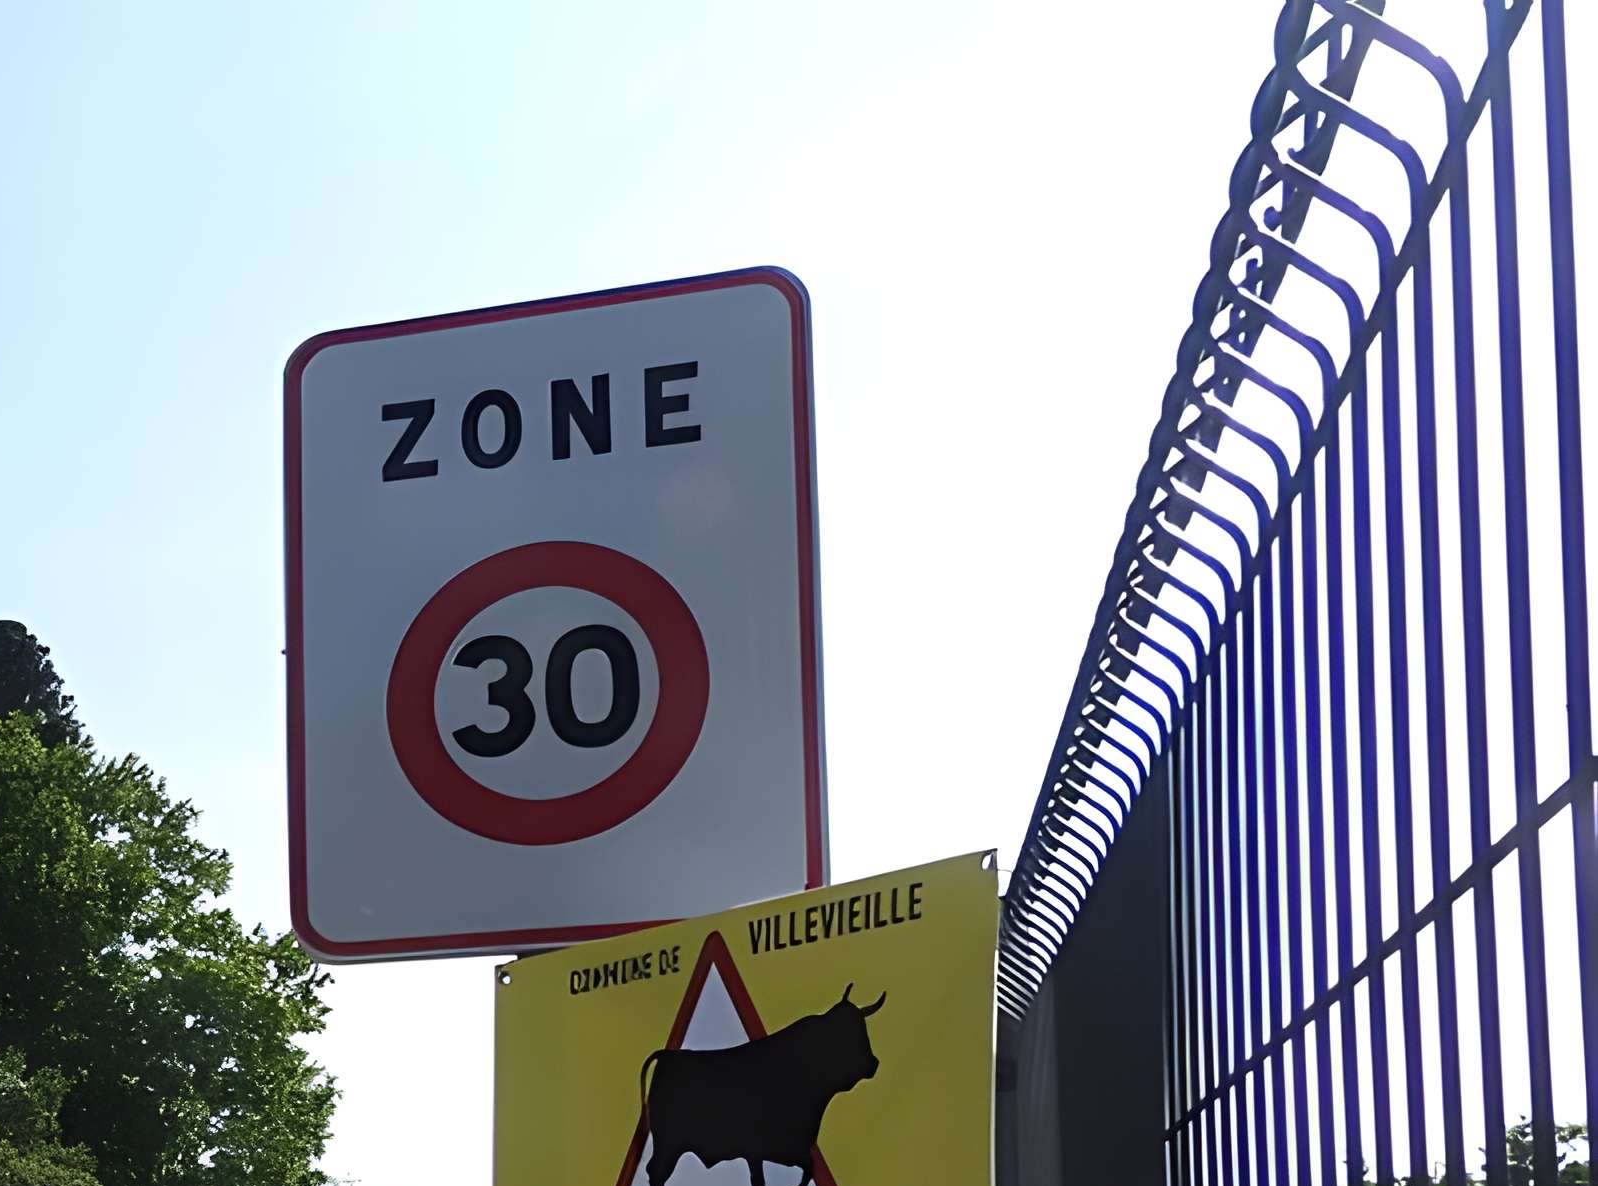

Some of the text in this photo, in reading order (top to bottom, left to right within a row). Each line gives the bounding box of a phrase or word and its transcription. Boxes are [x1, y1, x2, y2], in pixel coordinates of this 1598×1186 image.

[382, 361, 702, 482] ZONE
[451, 624, 641, 758] 30
[748, 882, 923, 955] VILLEVIEILLE
